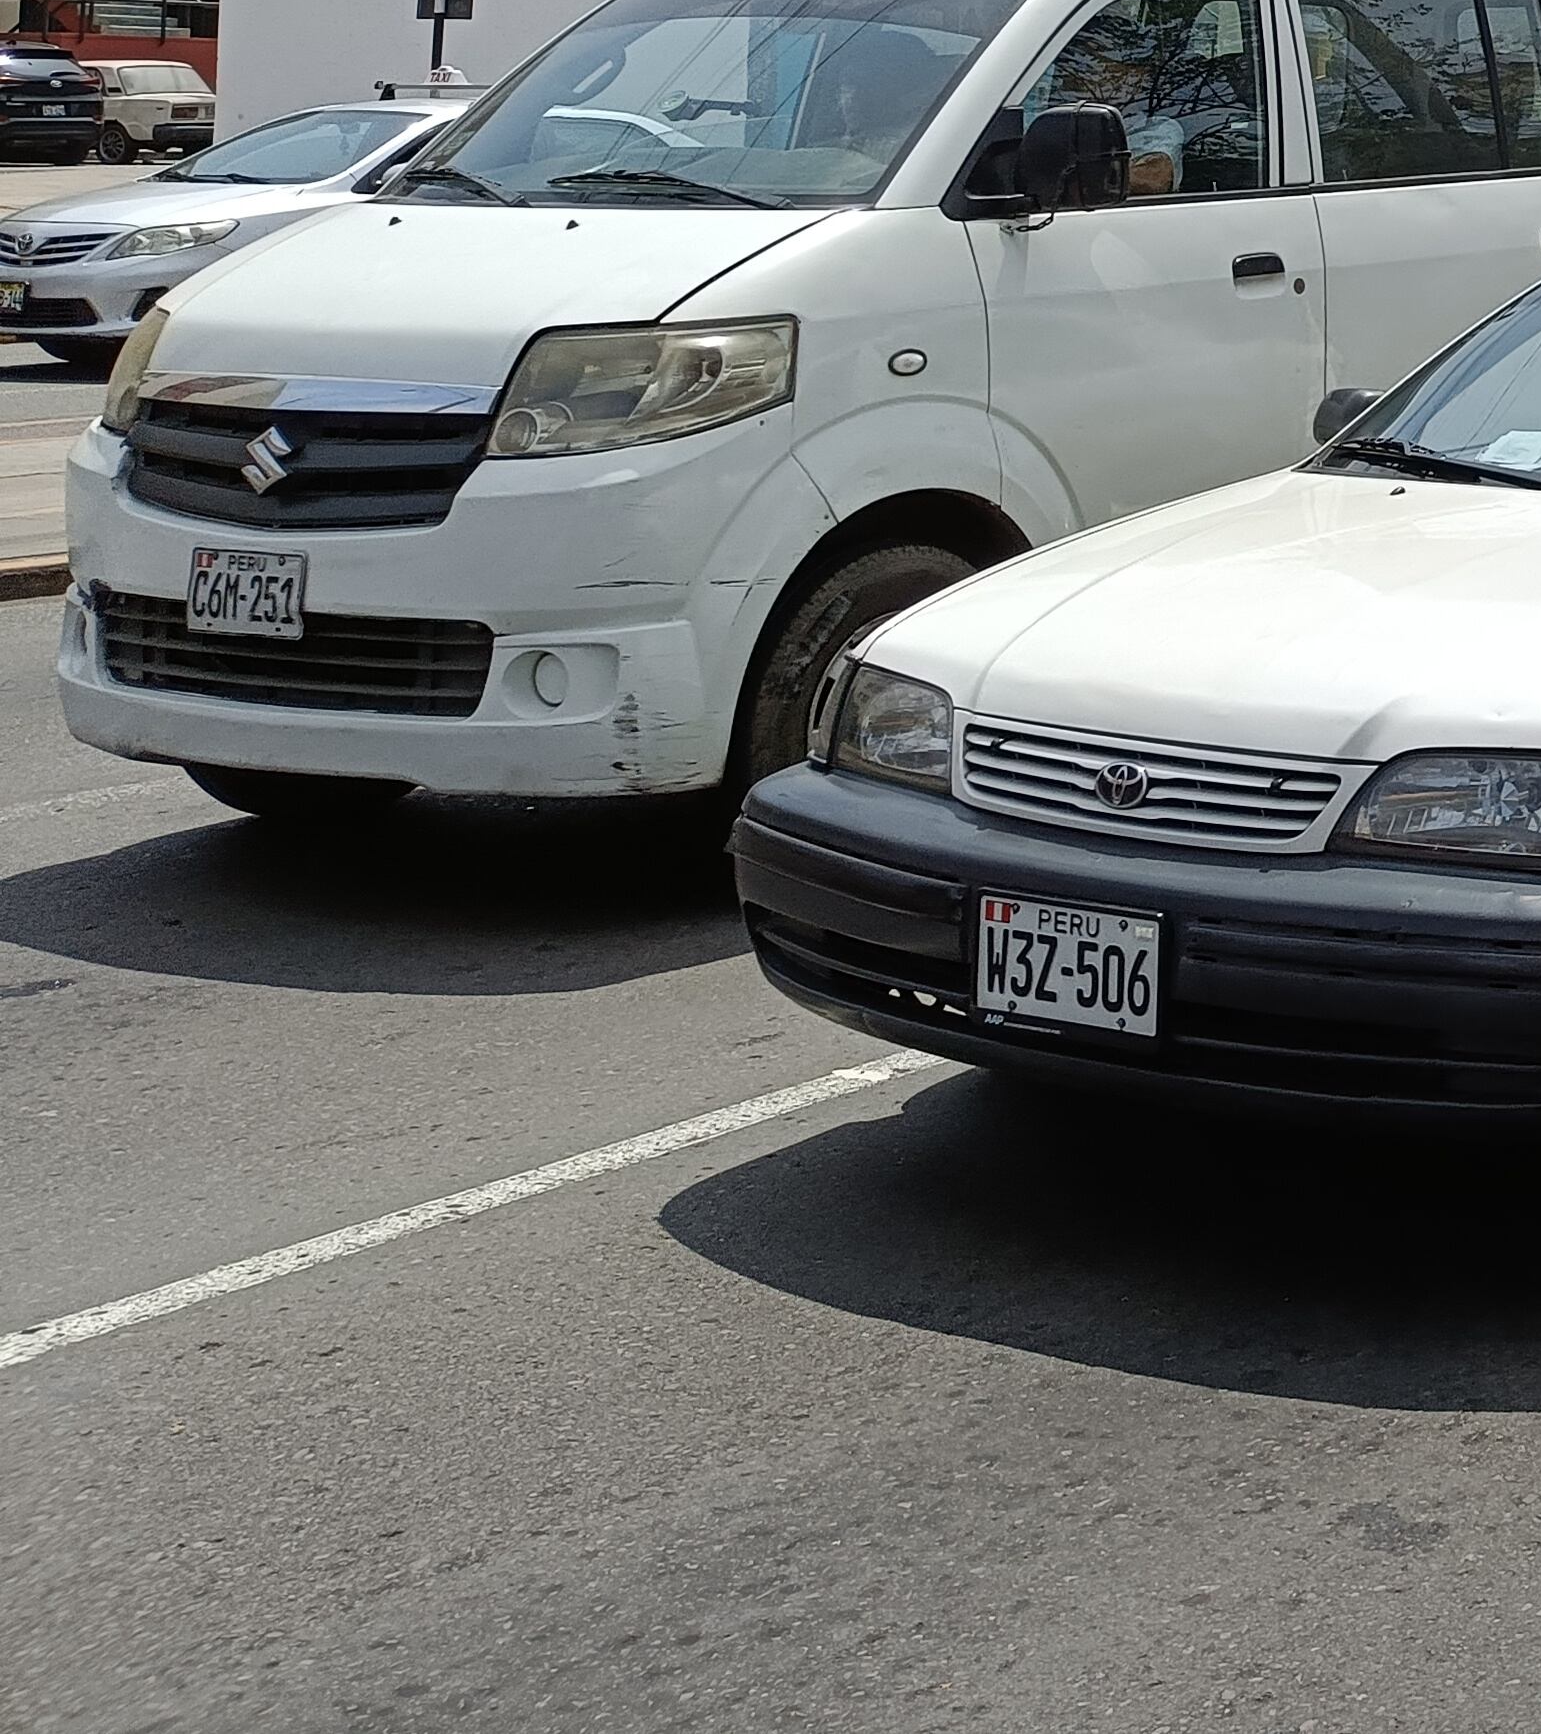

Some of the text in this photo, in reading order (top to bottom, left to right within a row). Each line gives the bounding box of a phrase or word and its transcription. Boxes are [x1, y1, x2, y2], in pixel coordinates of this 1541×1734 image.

[430, 71, 452, 83] TAXI
[227, 554, 268, 572] PERU
[192, 570, 295, 625] C6M-251
[1038, 908, 1100, 938] PERU
[987, 926, 1150, 1016] W3Z-506
